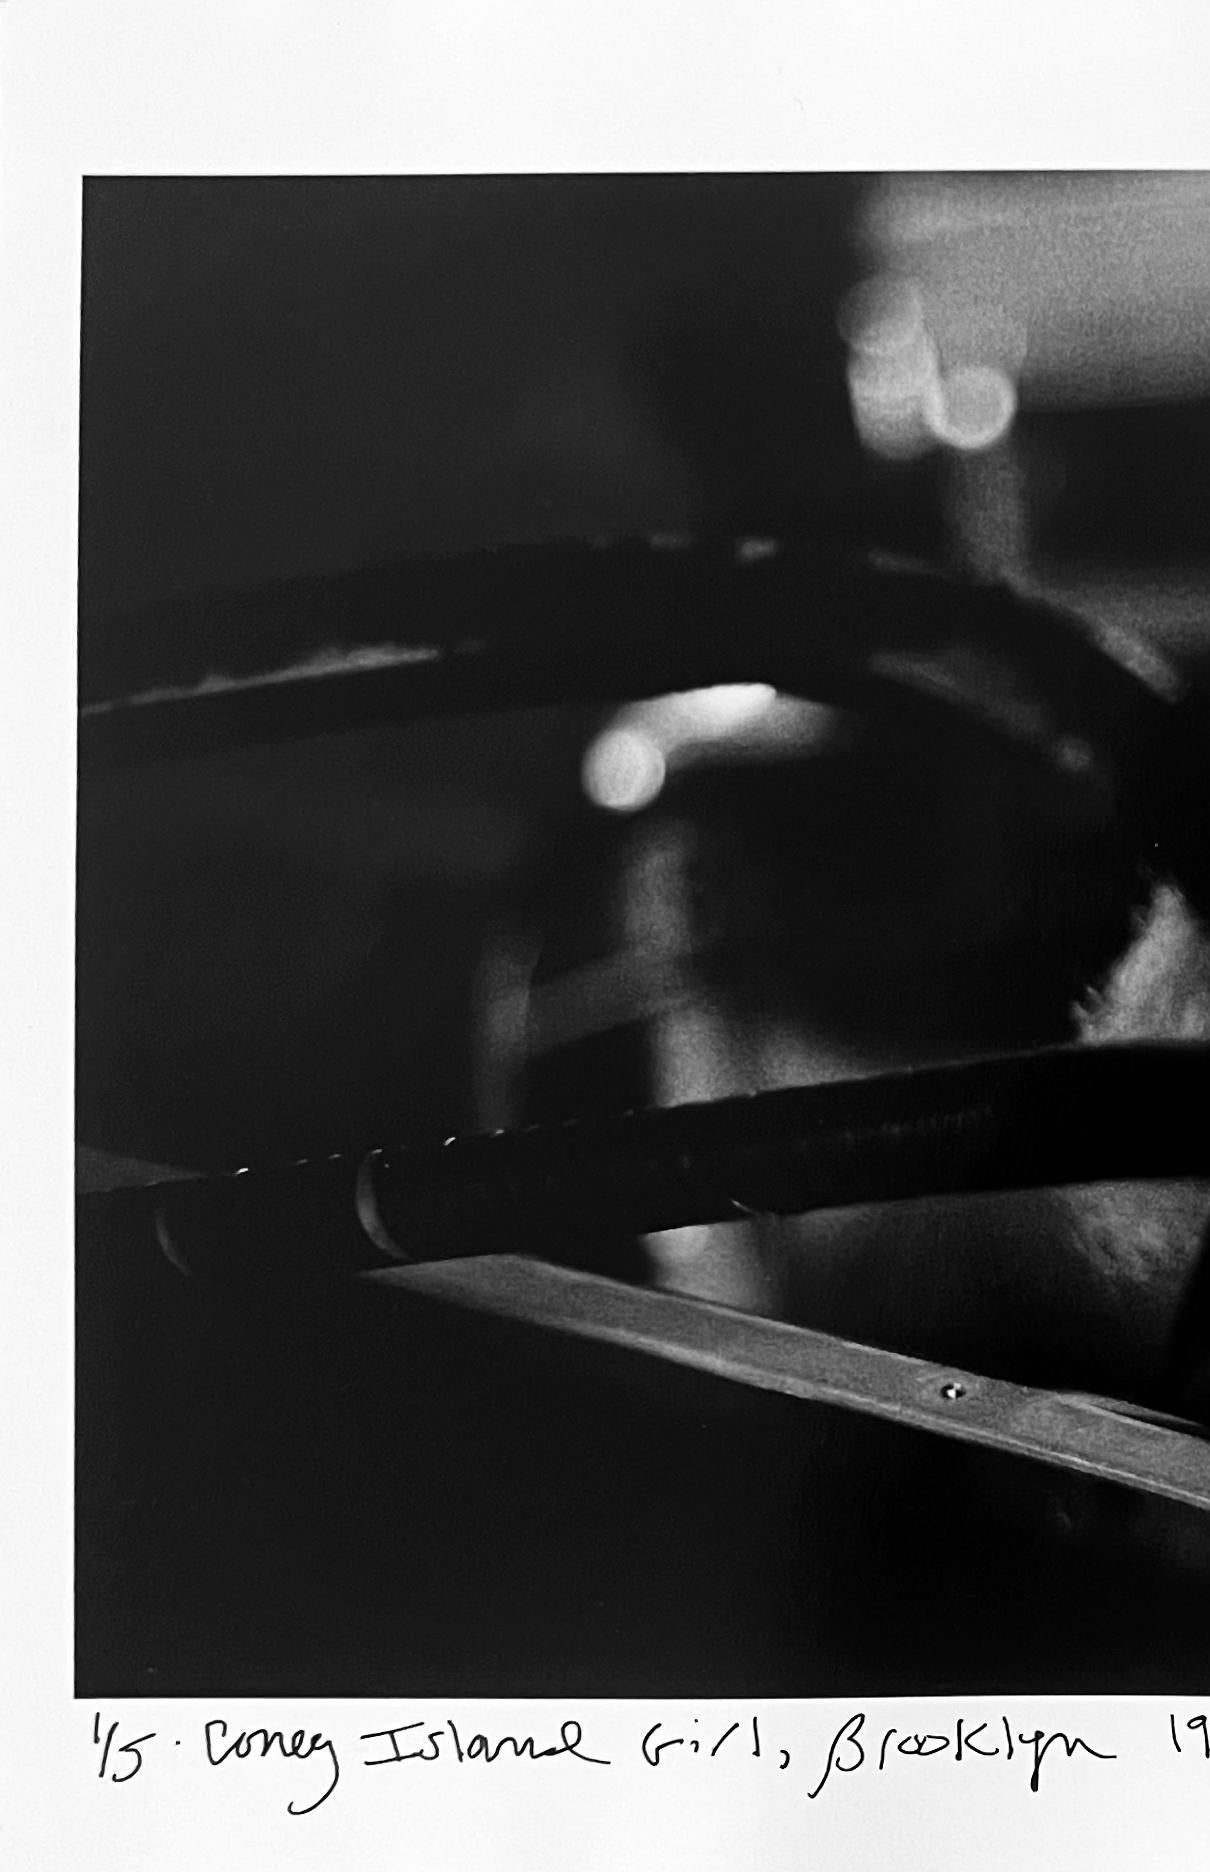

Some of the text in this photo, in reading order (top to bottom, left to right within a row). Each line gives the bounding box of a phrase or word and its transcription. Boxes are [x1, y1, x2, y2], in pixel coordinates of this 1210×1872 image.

[204, 1719, 340, 1816] Coney
[360, 1719, 611, 1766] Island
[641, 1716, 791, 1770] Girl,
[807, 1712, 1118, 1799] Brooklyn
